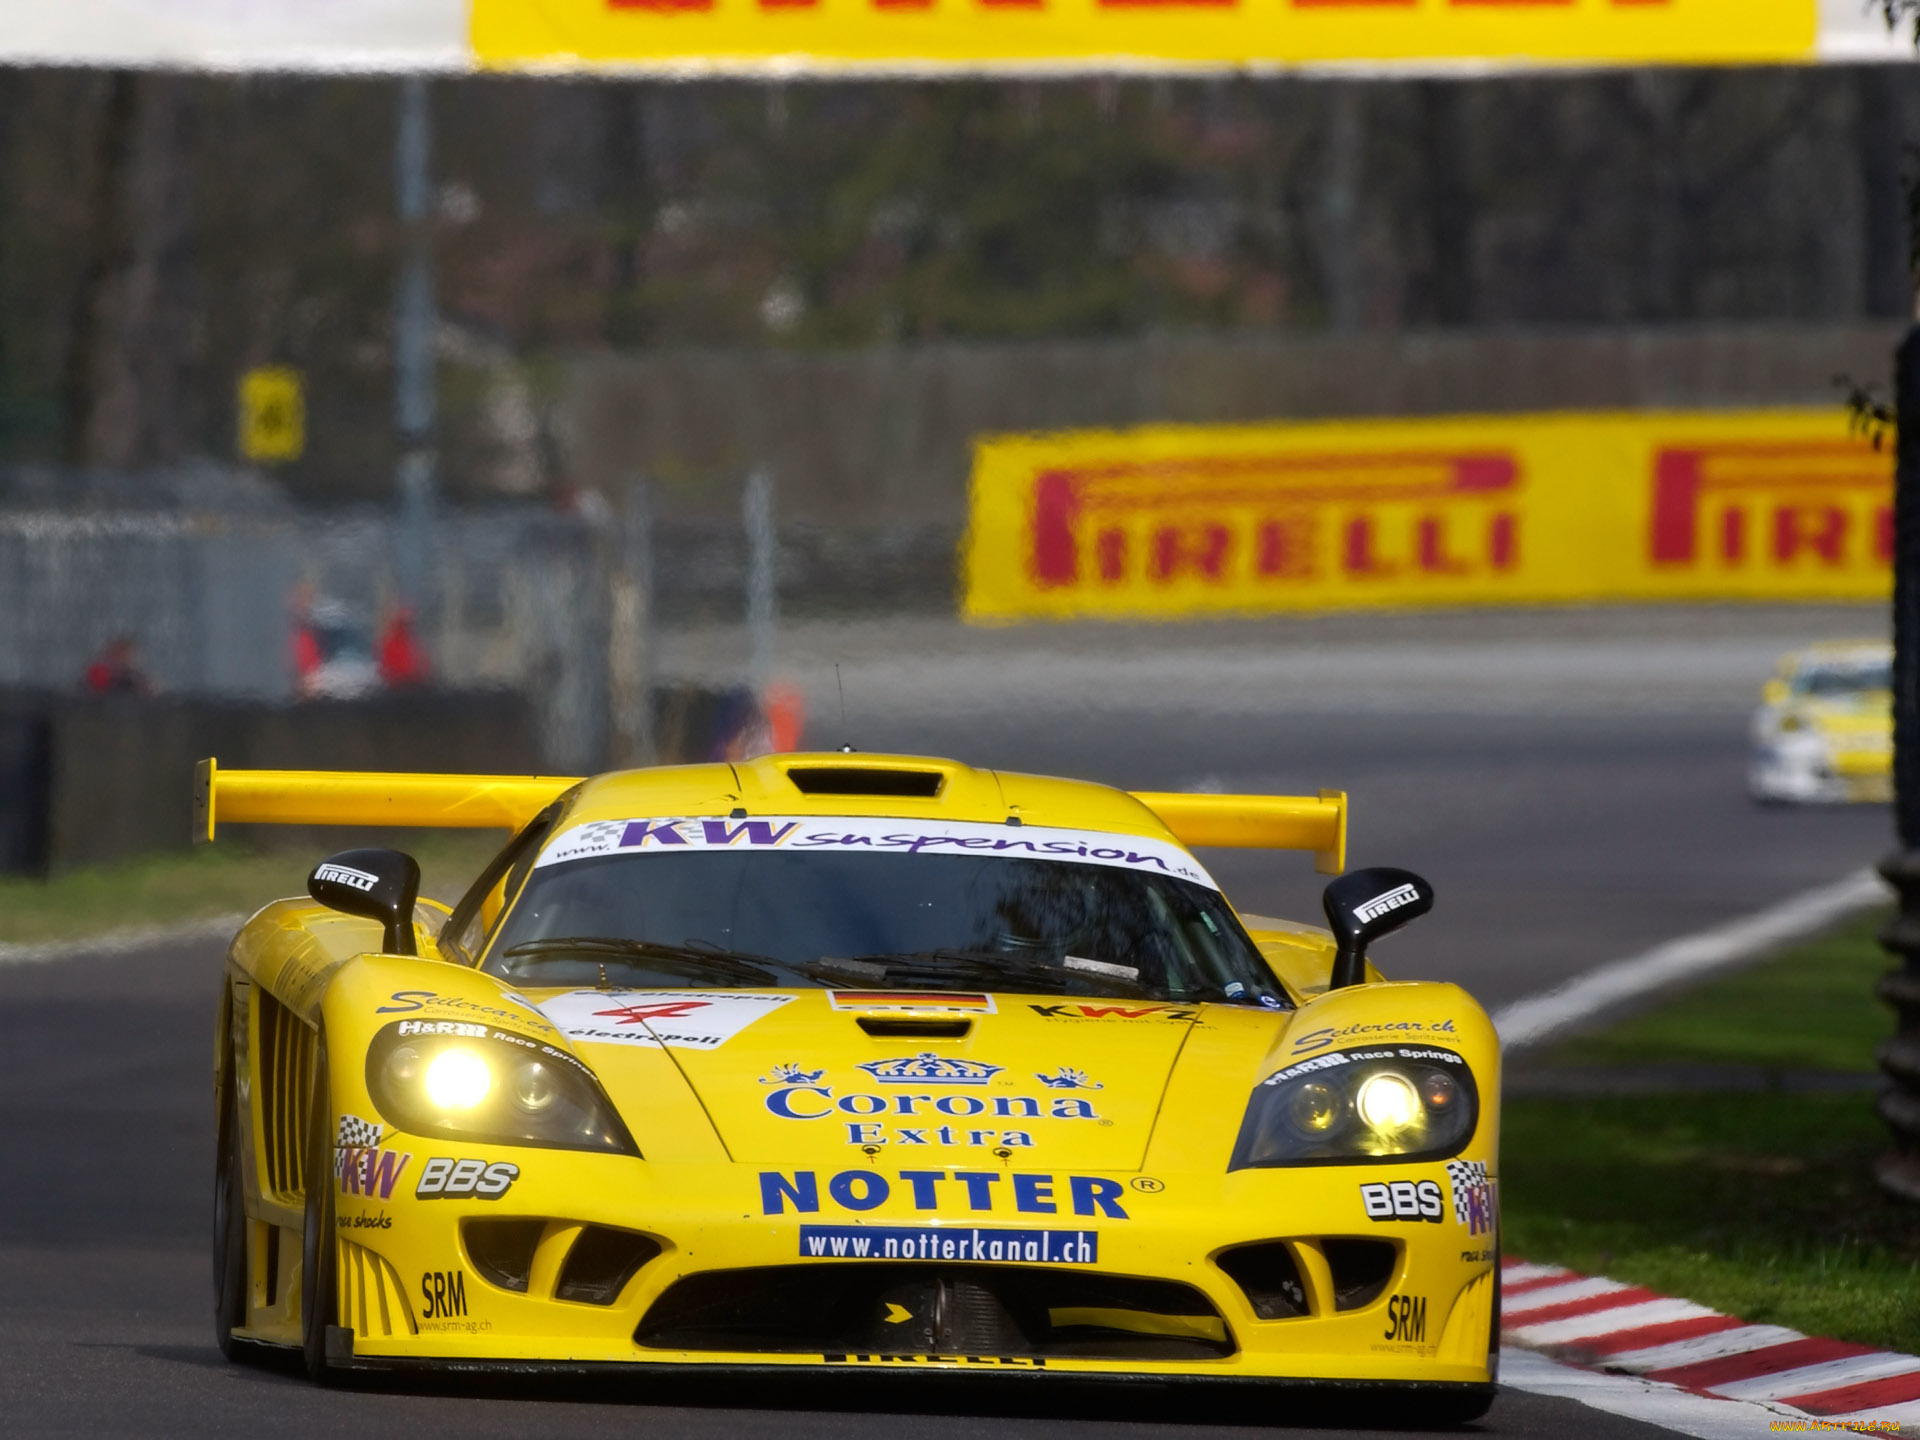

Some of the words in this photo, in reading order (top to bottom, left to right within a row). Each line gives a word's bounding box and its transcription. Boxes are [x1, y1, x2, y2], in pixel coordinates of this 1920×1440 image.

[1030, 452, 1521, 588] PIRELLI
[791, 831, 1171, 872] suspension
[314, 863, 379, 892] PIRELLI
[1352, 883, 1420, 924] PIRELLI
[591, 1001, 714, 1026] 4
[1027, 1004, 1204, 1024] KWZ
[493, 1031, 536, 1049] Race
[1291, 1019, 1457, 1056] Seilercar.ch
[1350, 1050, 1395, 1061] Race
[1398, 1049, 1463, 1065] Springs
[765, 1086, 1100, 1121] Corona
[845, 1122, 1035, 1148] Extra
[342, 1145, 413, 1202] KW
[416, 1157, 520, 1200] BBS
[757, 1169, 1131, 1220] NOTTER
[1360, 1180, 1444, 1224] BBS
[353, 1208, 392, 1229] shocks
[807, 1229, 1092, 1263] www.notterkanal.ch
[422, 1271, 468, 1319] SRM
[419, 1319, 492, 1335] www.srm-ag.ch
[1384, 1294, 1426, 1343] SRM
